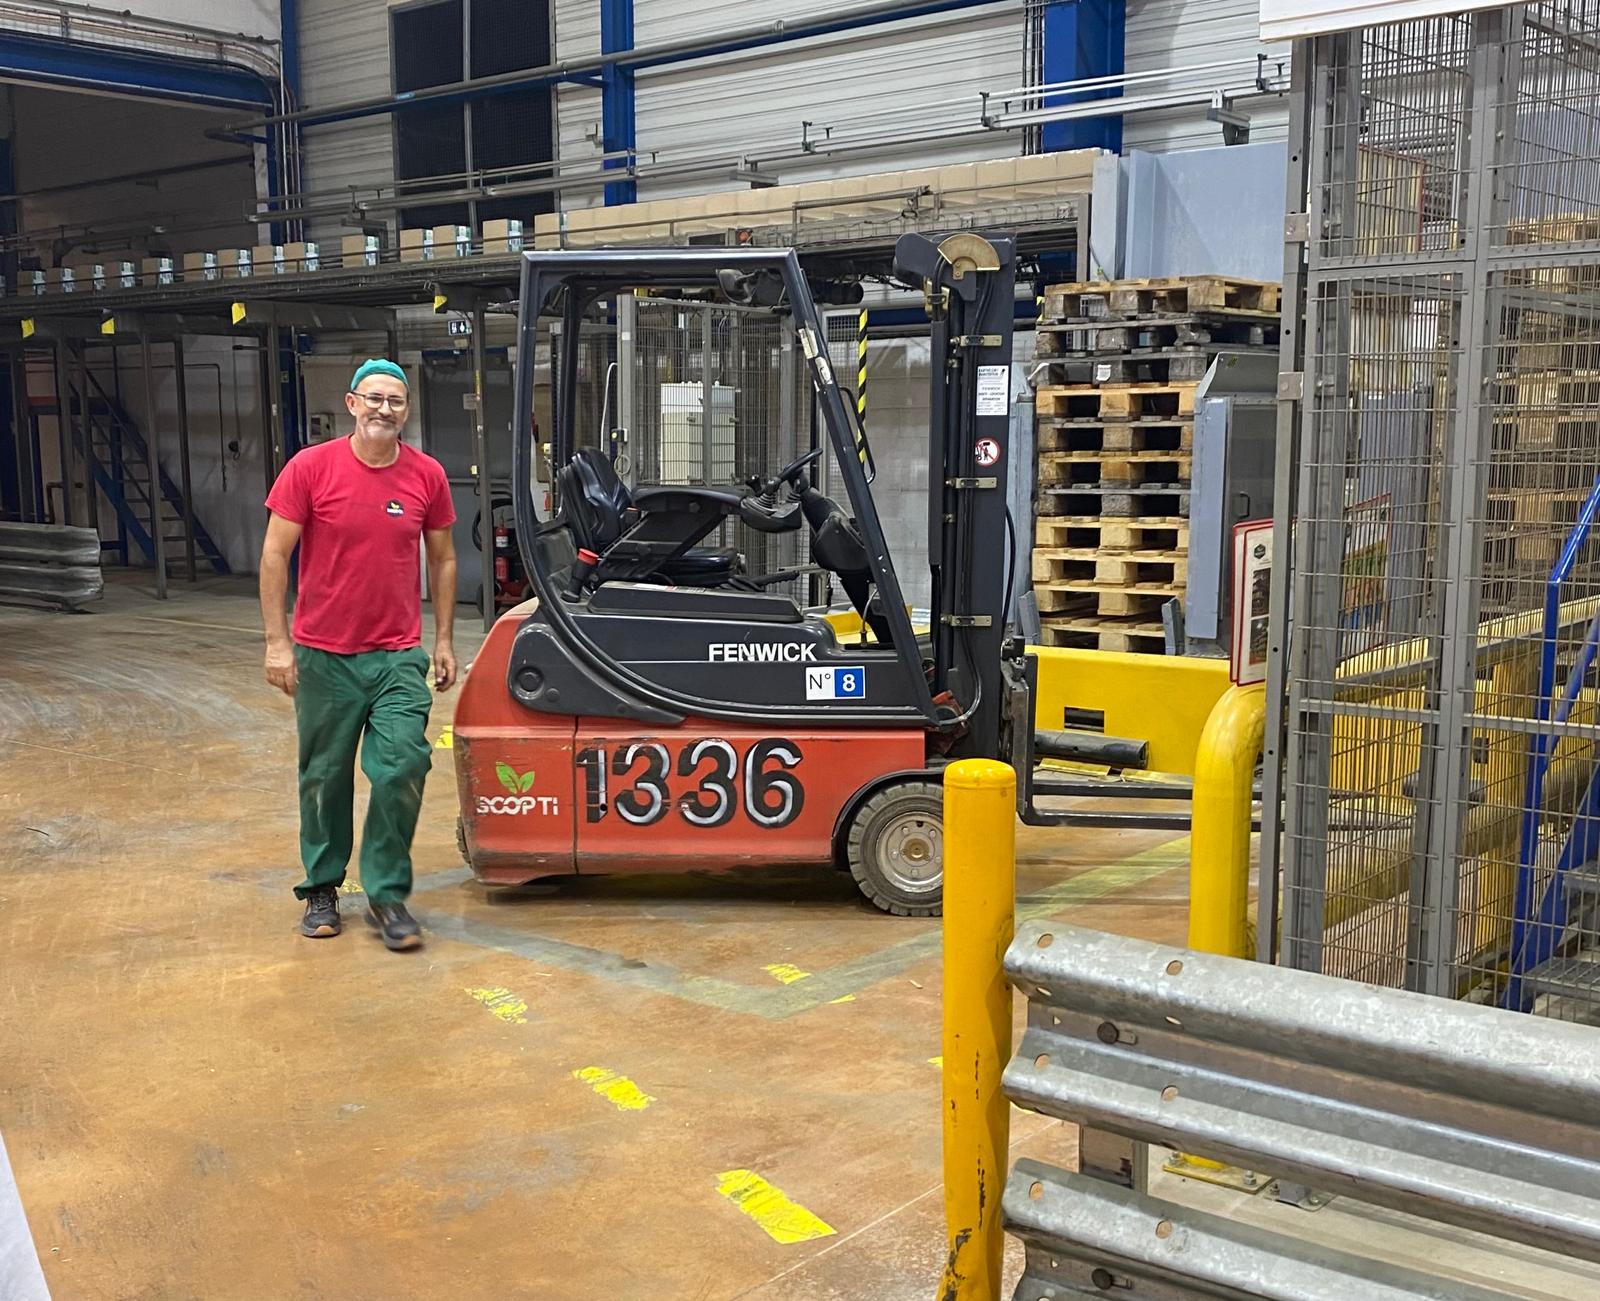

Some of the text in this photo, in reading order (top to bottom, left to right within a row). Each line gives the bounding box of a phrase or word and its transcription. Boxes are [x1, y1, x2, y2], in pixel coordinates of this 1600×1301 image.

[708, 642, 818, 662] FENWICK
[809, 673, 856, 692] N° 8
[576, 737, 805, 829] 1336
